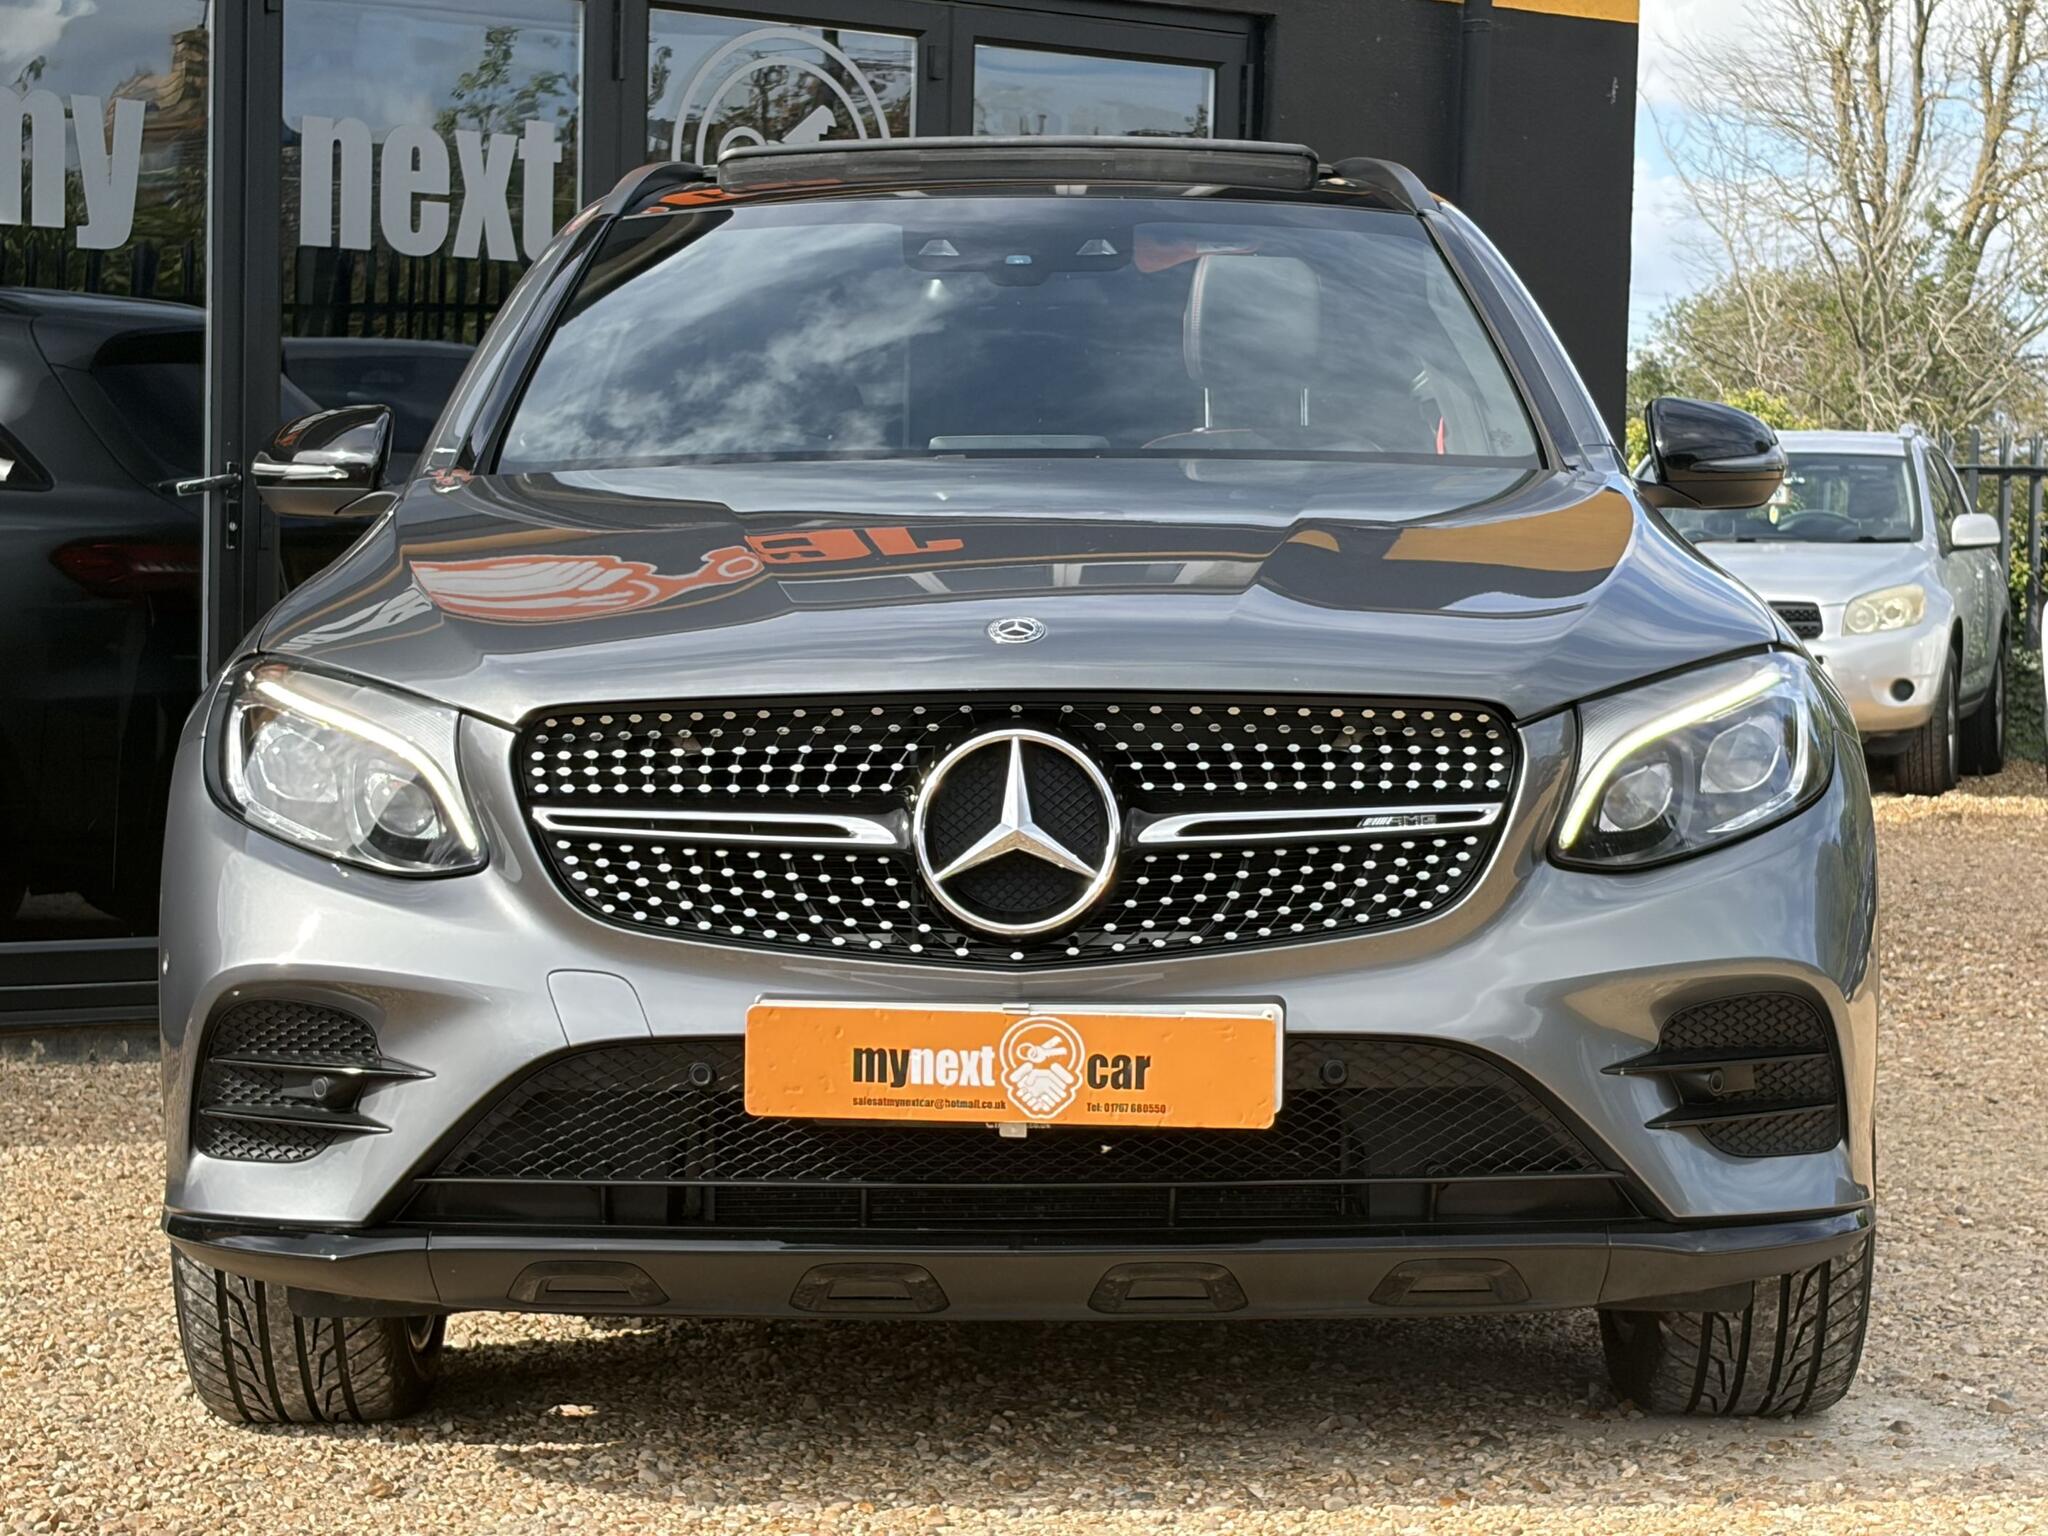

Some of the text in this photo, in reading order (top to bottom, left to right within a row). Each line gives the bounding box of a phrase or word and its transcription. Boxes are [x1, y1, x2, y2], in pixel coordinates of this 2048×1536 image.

[0, 85, 562, 262] my next
[852, 1045, 1151, 1090] mynext car
[852, 1096, 1006, 1109] salesatmynextcar@hotmail.co.uk
[1086, 1102, 1102, 1112] Tel:
